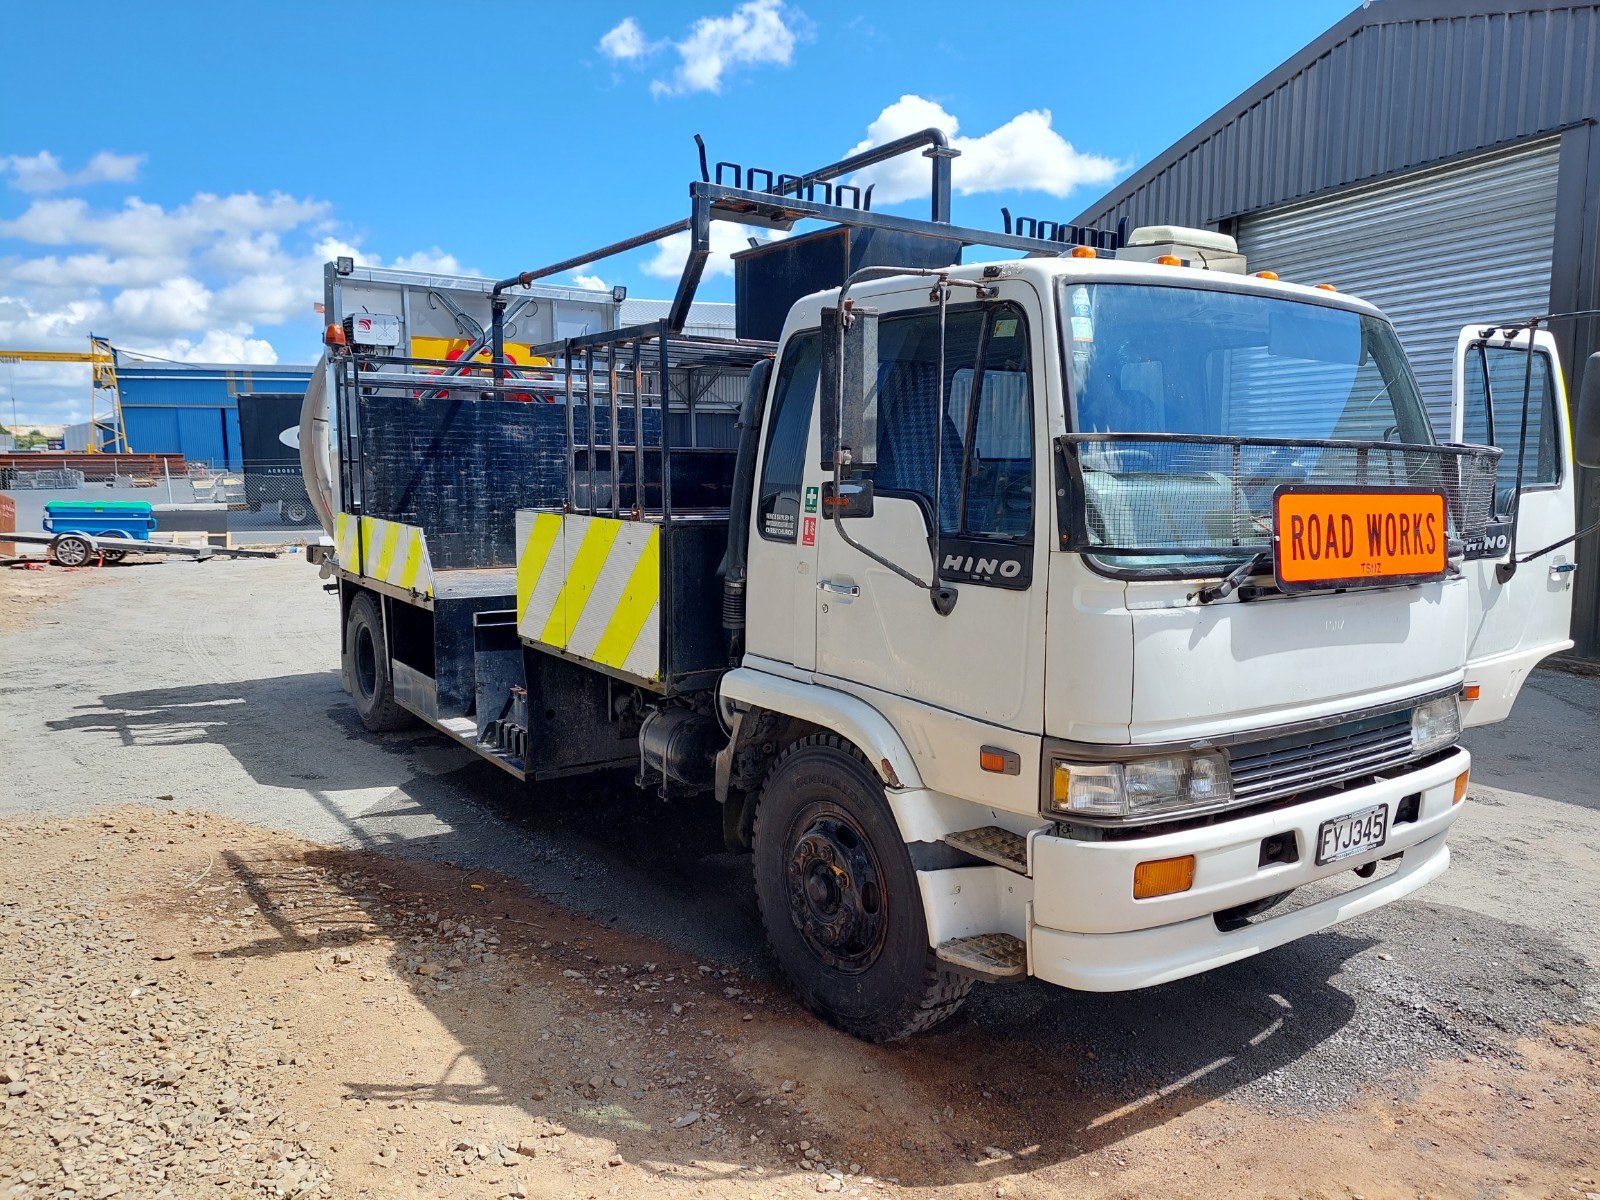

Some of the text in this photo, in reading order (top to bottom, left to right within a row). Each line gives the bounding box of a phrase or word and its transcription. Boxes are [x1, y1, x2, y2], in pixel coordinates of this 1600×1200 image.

[1291, 513, 1435, 560] ROAD WORKS
[943, 554, 1021, 577] HINO
[1322, 813, 1383, 856] FYJ345
